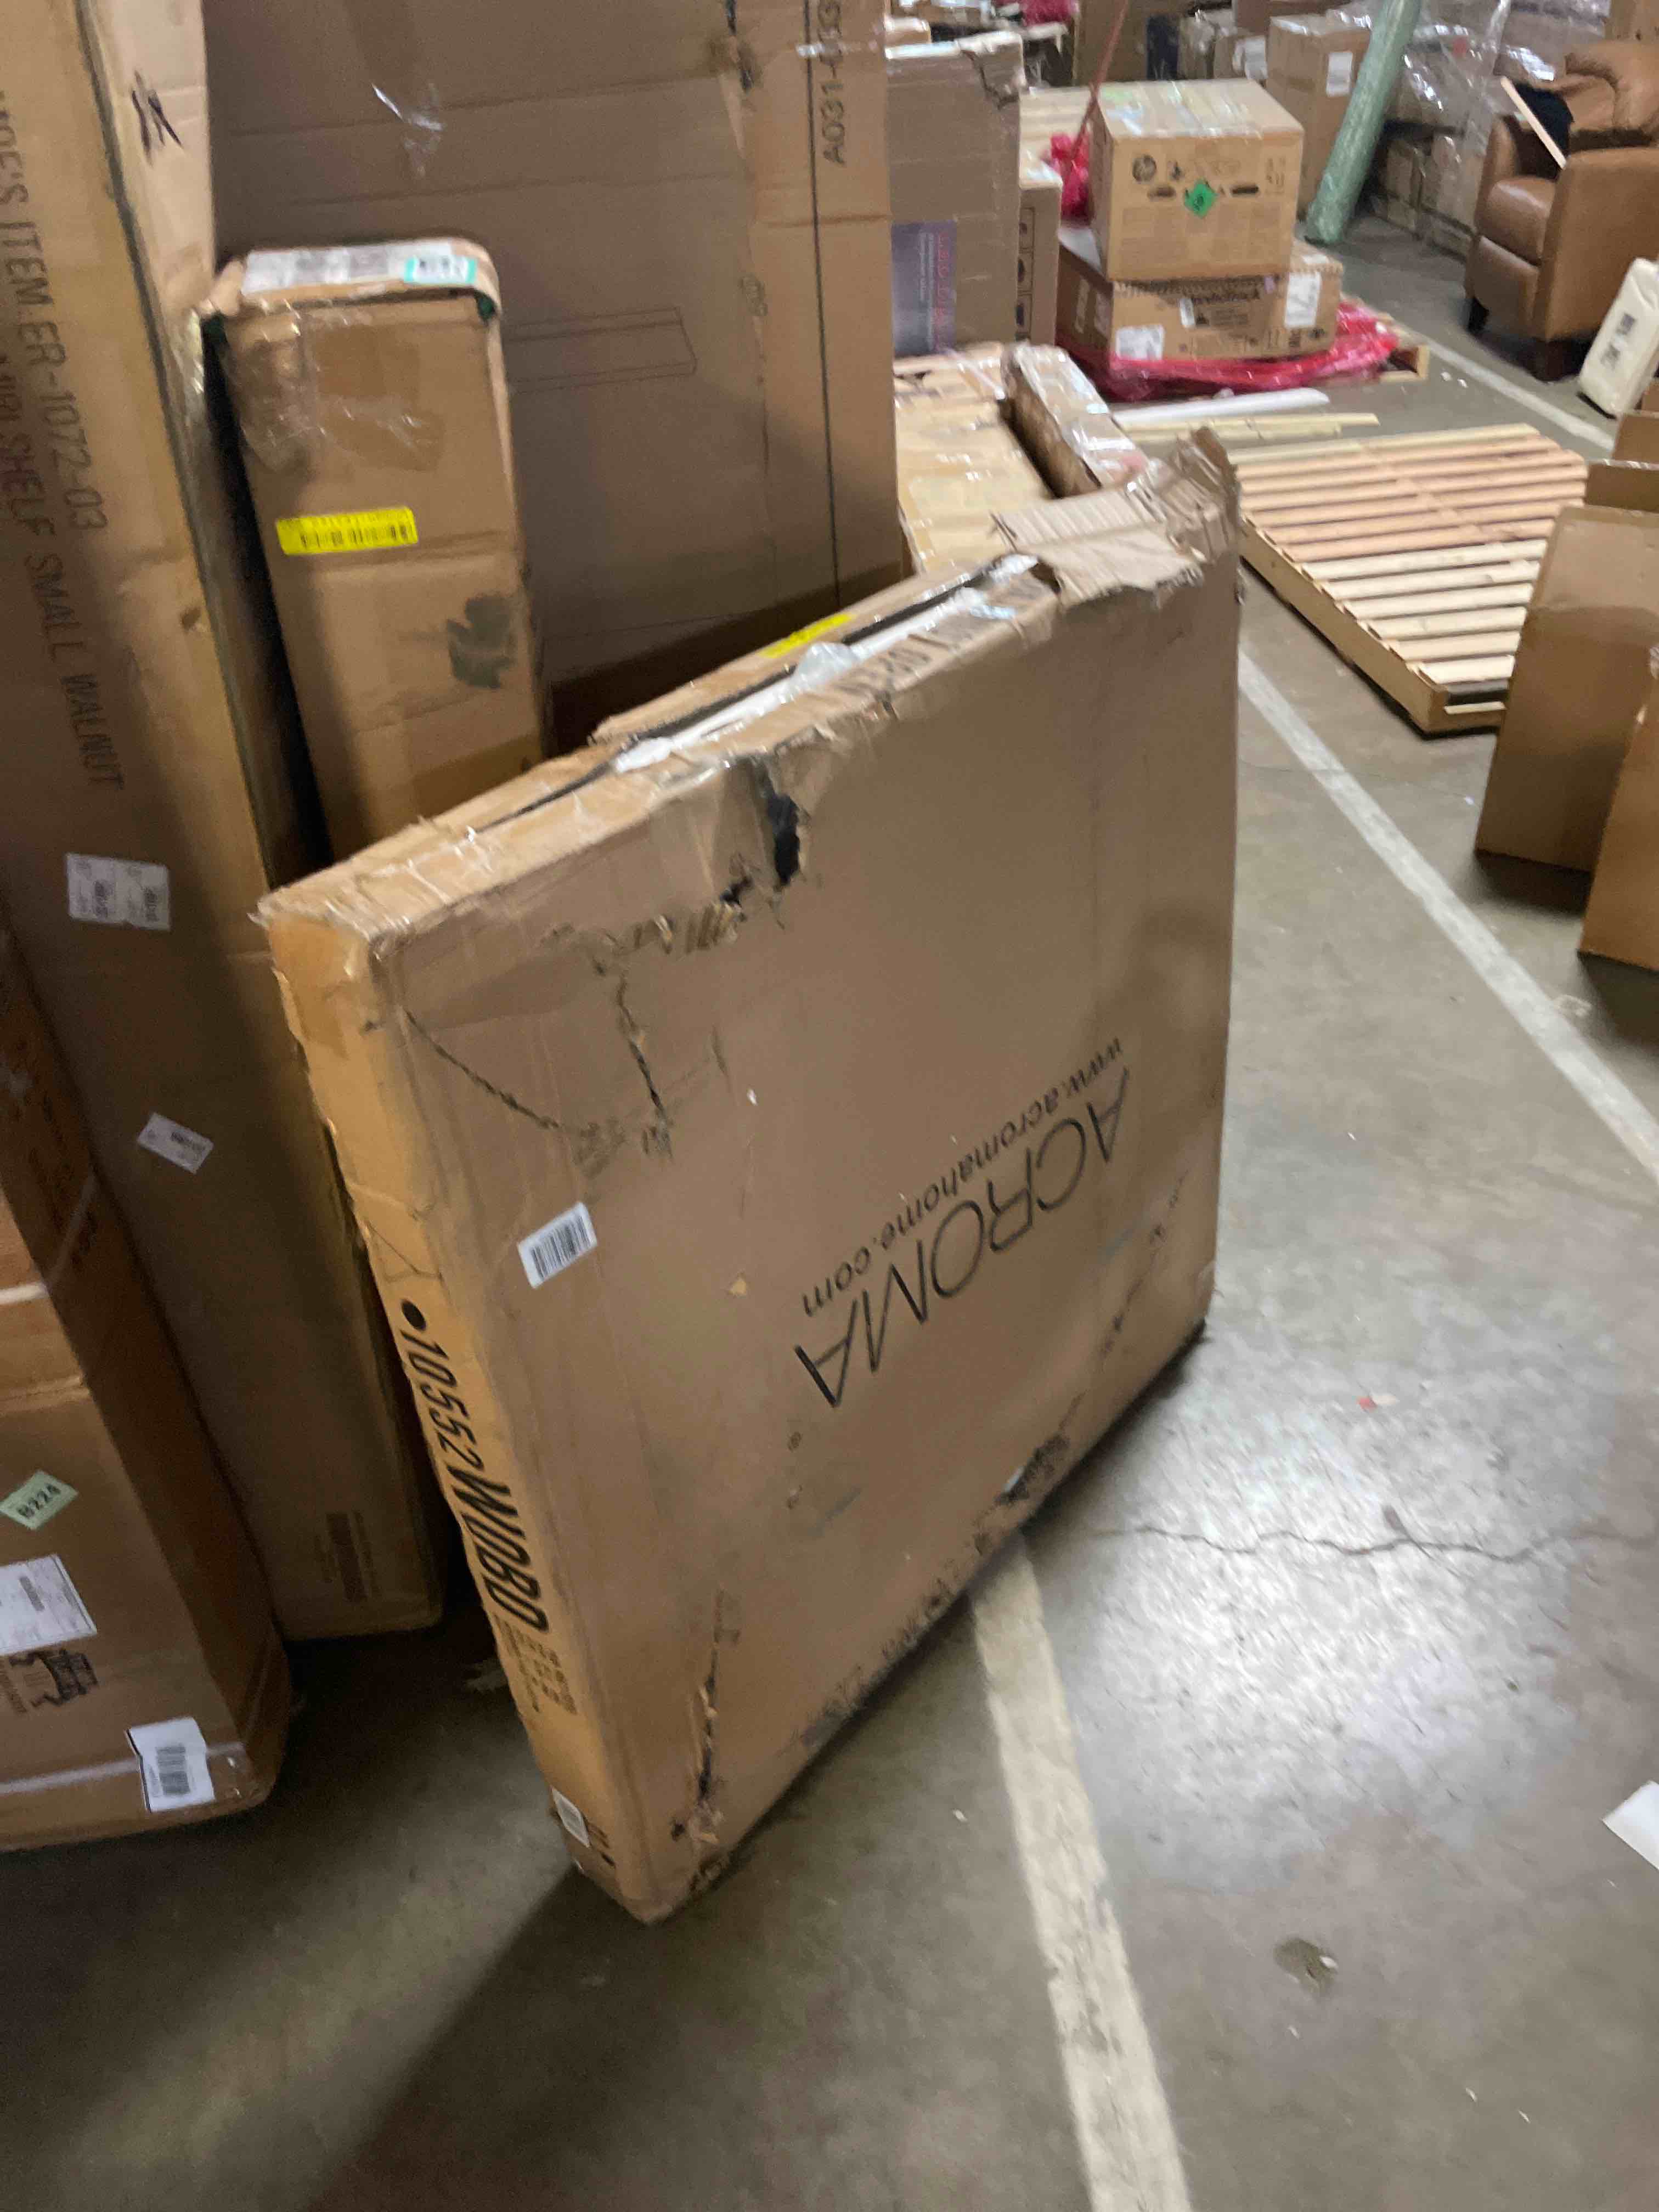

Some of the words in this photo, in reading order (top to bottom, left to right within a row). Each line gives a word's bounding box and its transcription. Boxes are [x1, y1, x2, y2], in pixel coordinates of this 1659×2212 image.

[24, 553, 83, 663] SMALL
[60, 673, 125, 790] WALNUT
[794, 1066, 1130, 1408] ACROMA
[802, 1037, 1123, 1317] www.acromahome.com
